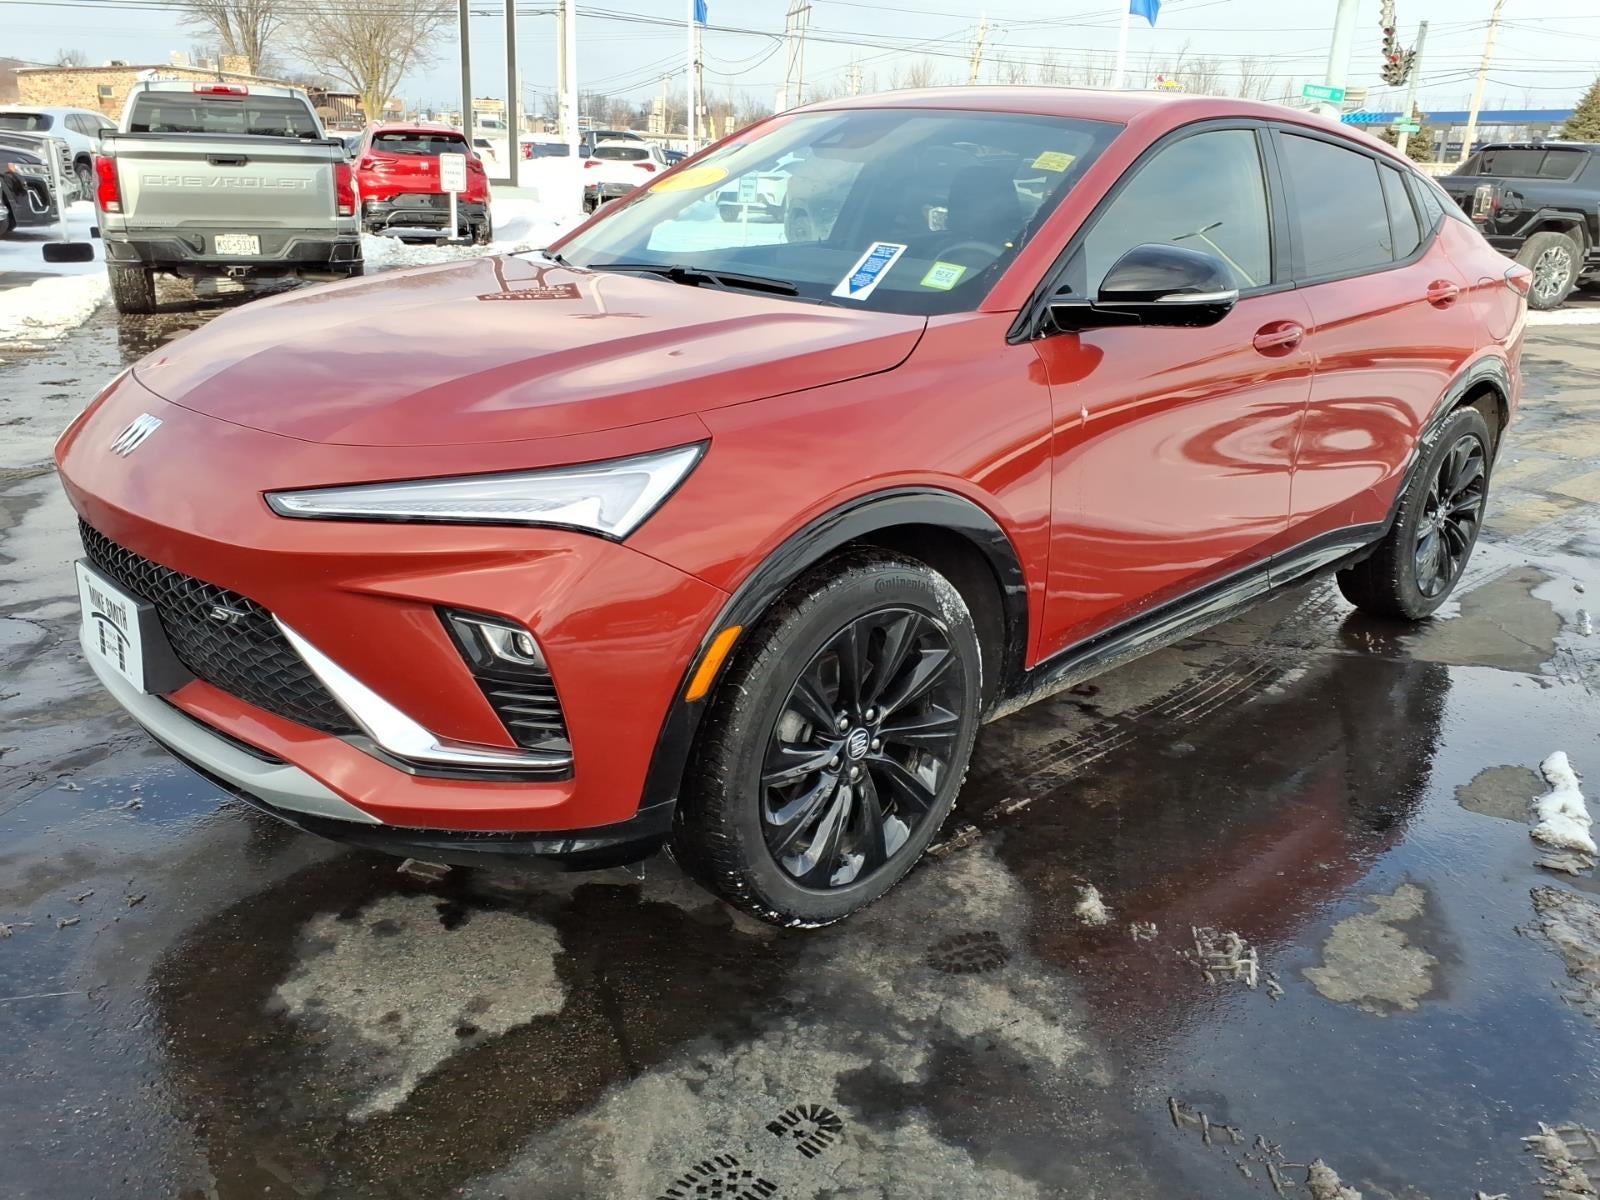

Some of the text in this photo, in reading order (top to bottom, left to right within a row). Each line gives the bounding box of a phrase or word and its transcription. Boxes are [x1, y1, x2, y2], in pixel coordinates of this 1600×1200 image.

[142, 174, 313, 190] CHEVROLET
[88, 583, 128, 632] MIKE SMITH
[210, 606, 245, 624] ST
